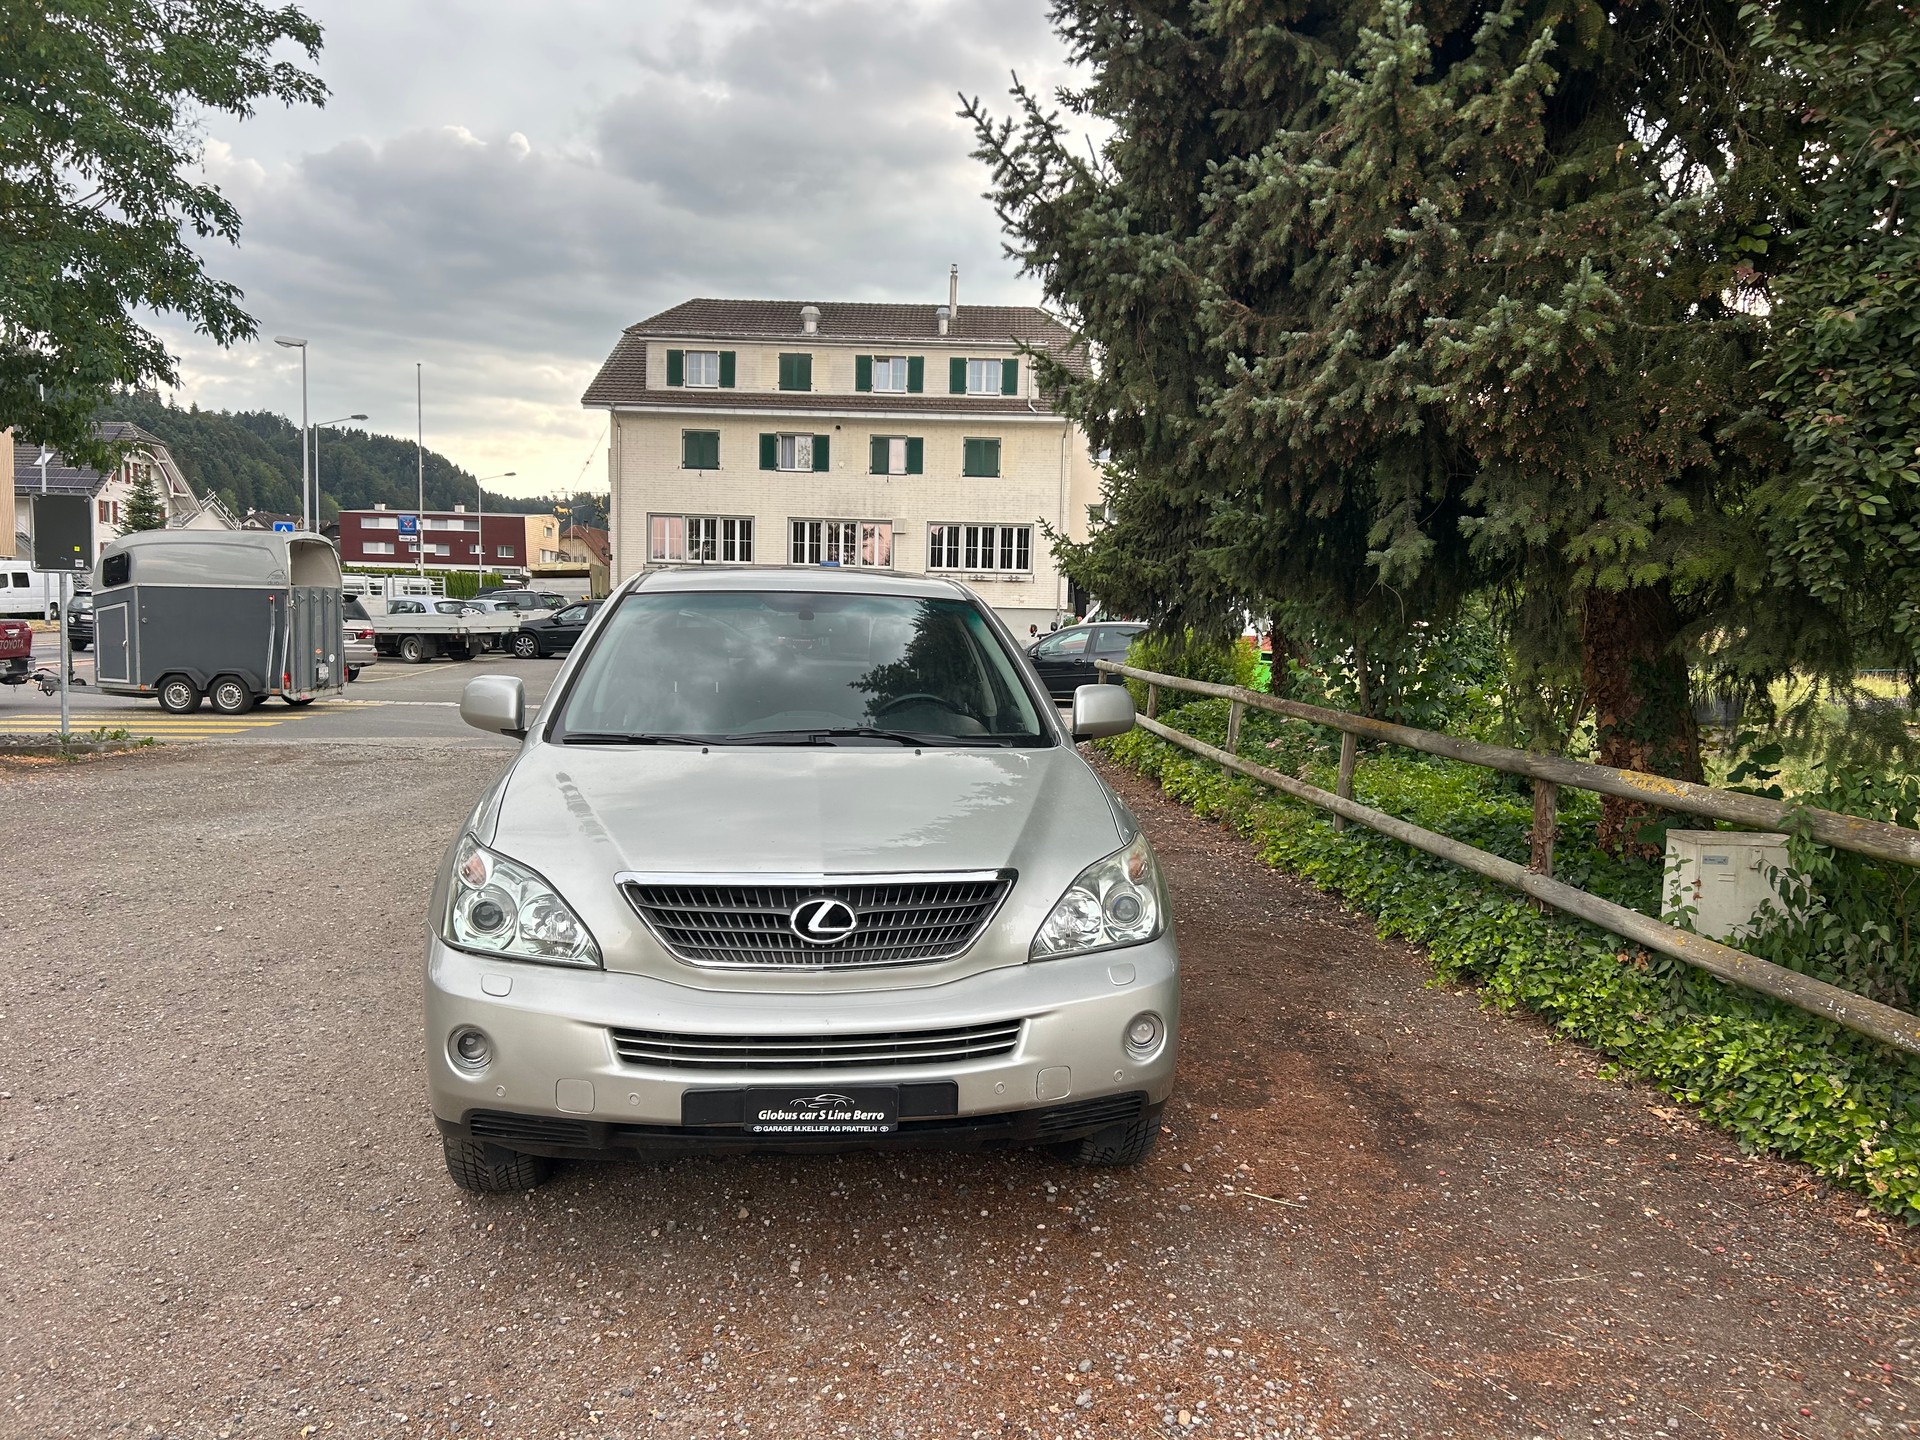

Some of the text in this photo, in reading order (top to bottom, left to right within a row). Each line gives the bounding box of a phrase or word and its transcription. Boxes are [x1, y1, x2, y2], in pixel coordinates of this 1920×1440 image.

[0, 639, 24, 650] TOYOTA
[758, 1109, 885, 1120] Globus car S Line Berro
